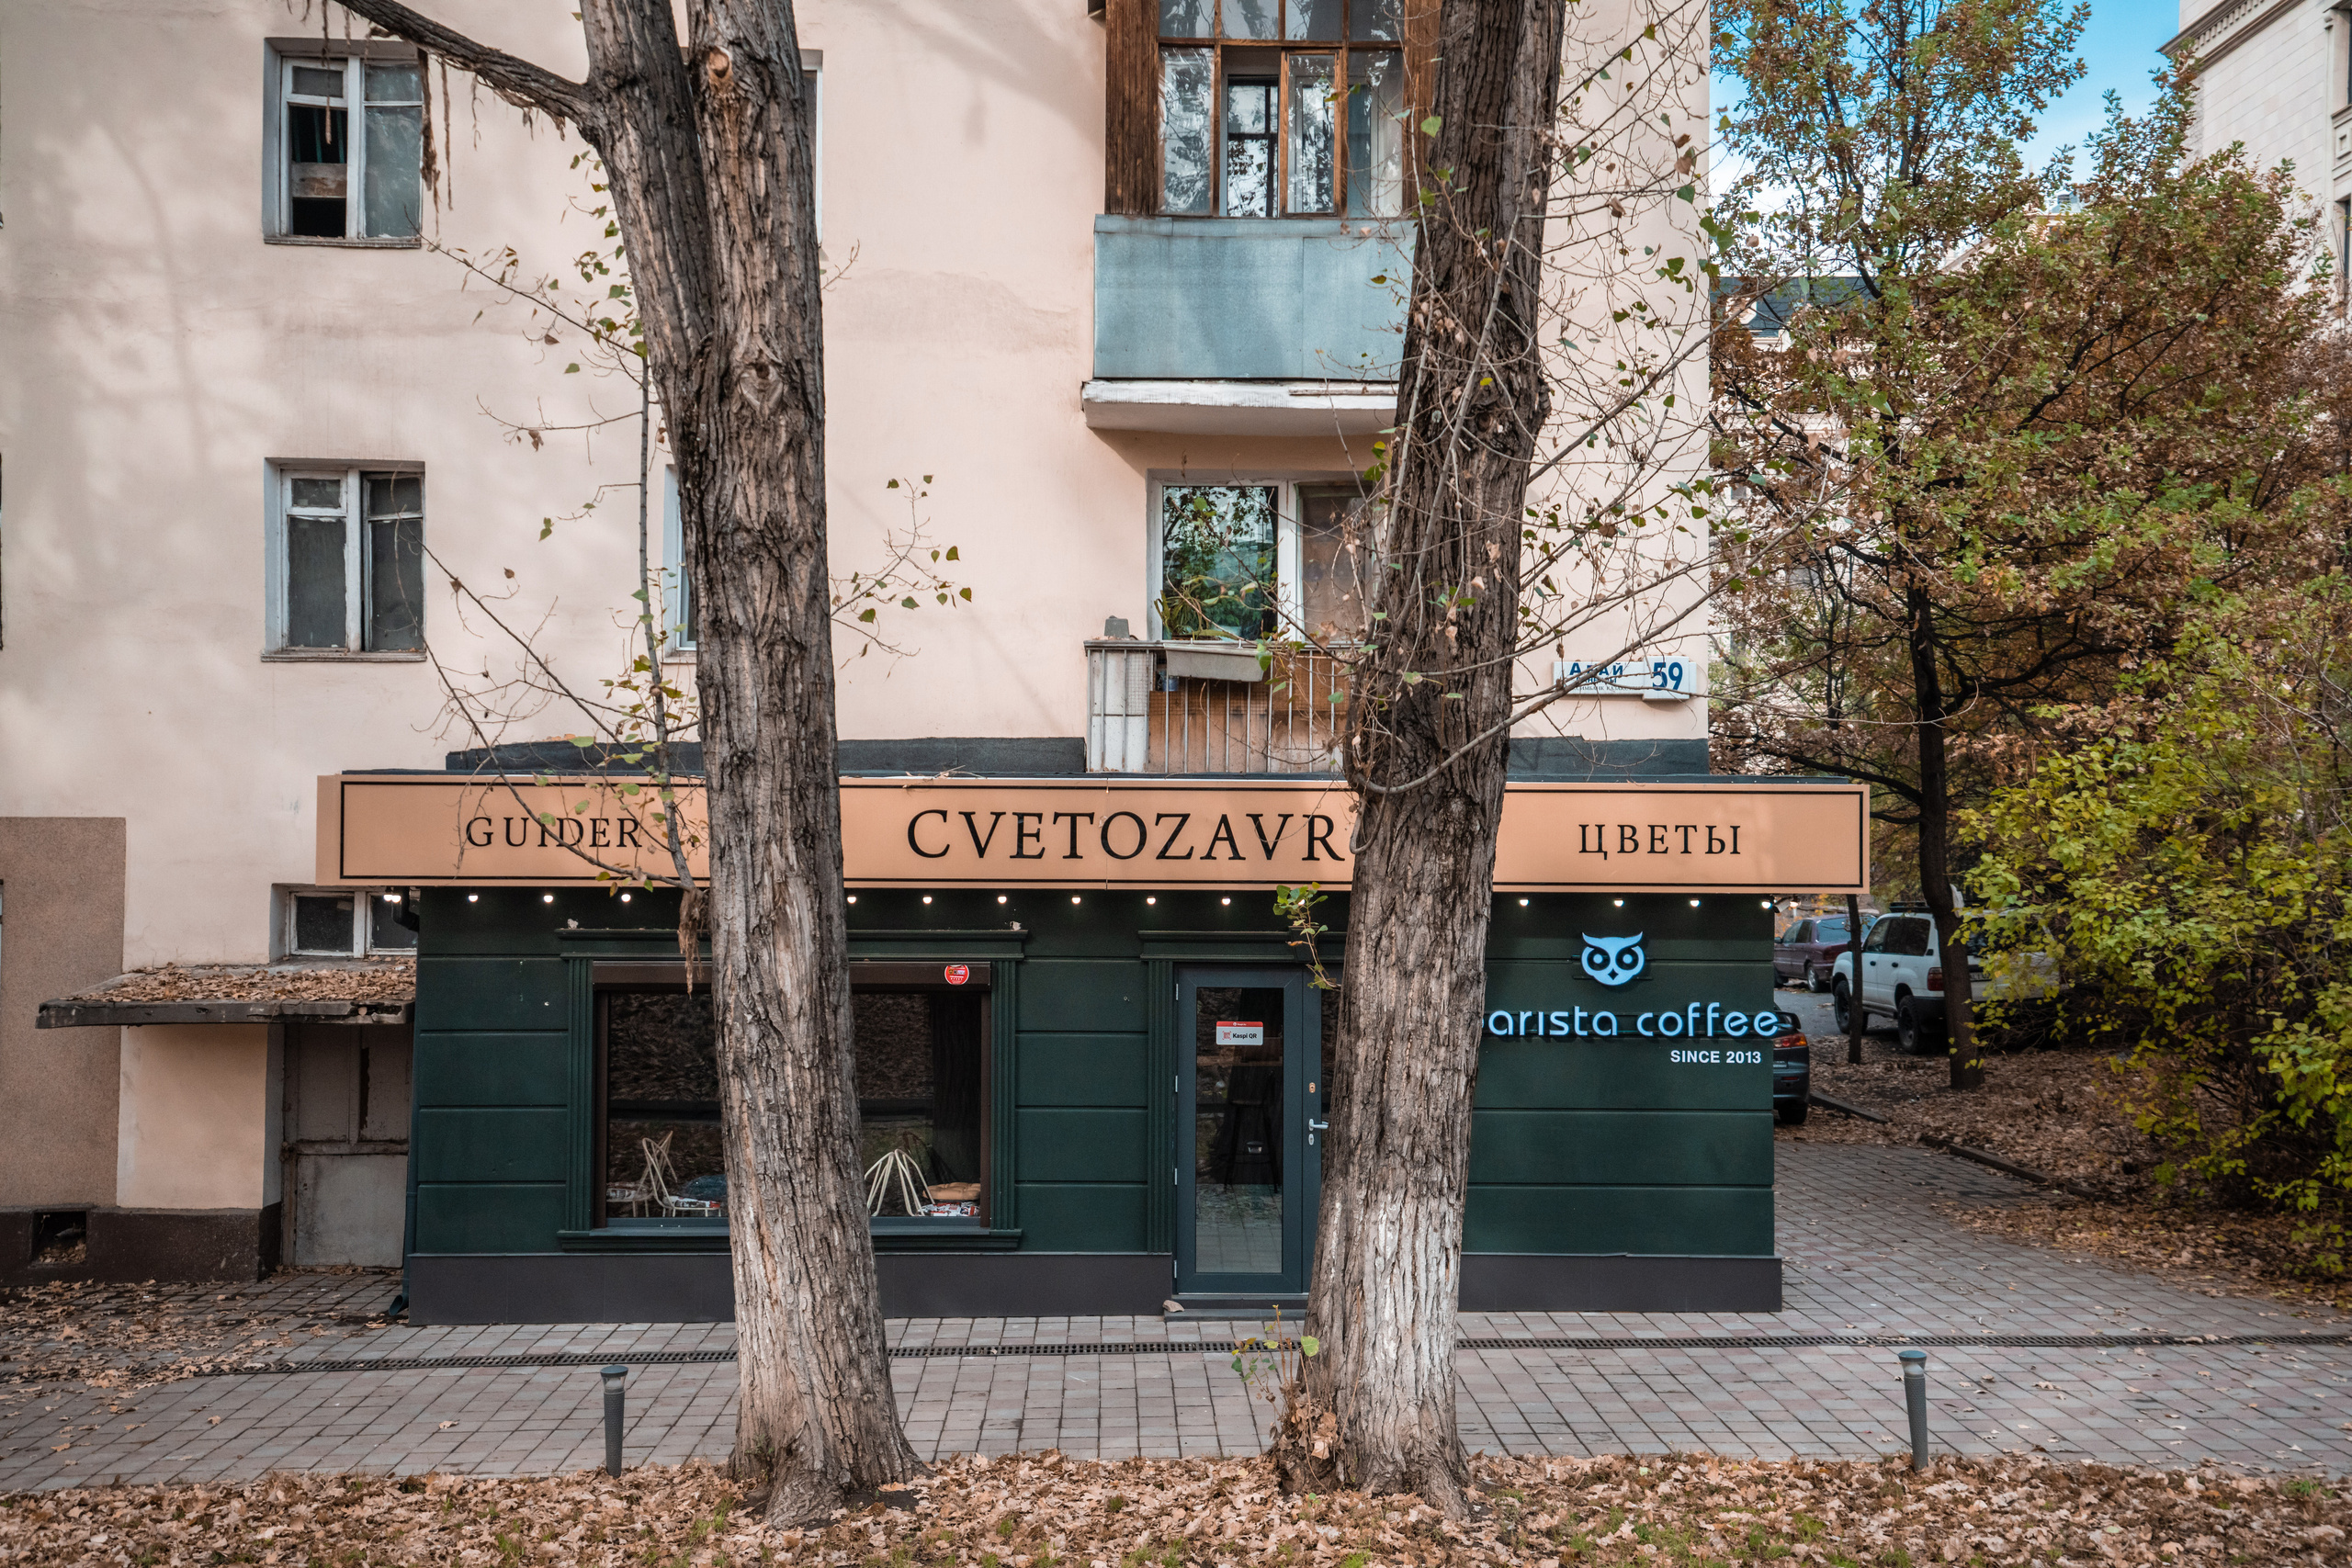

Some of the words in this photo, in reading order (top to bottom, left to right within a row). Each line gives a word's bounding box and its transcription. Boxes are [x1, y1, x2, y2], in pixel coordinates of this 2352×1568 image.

[1652, 661, 1683, 691] 59
[466, 817, 642, 848] GUIDER
[907, 809, 1345, 861] CVETOZAVR
[1578, 824, 1741, 861] ЦВЕТЫ
[1482, 1005, 1619, 1037] arista
[1636, 1001, 1780, 1038] coffee
[1670, 1050, 1721, 1064] SINCE
[1725, 1050, 1762, 1064] 2013
